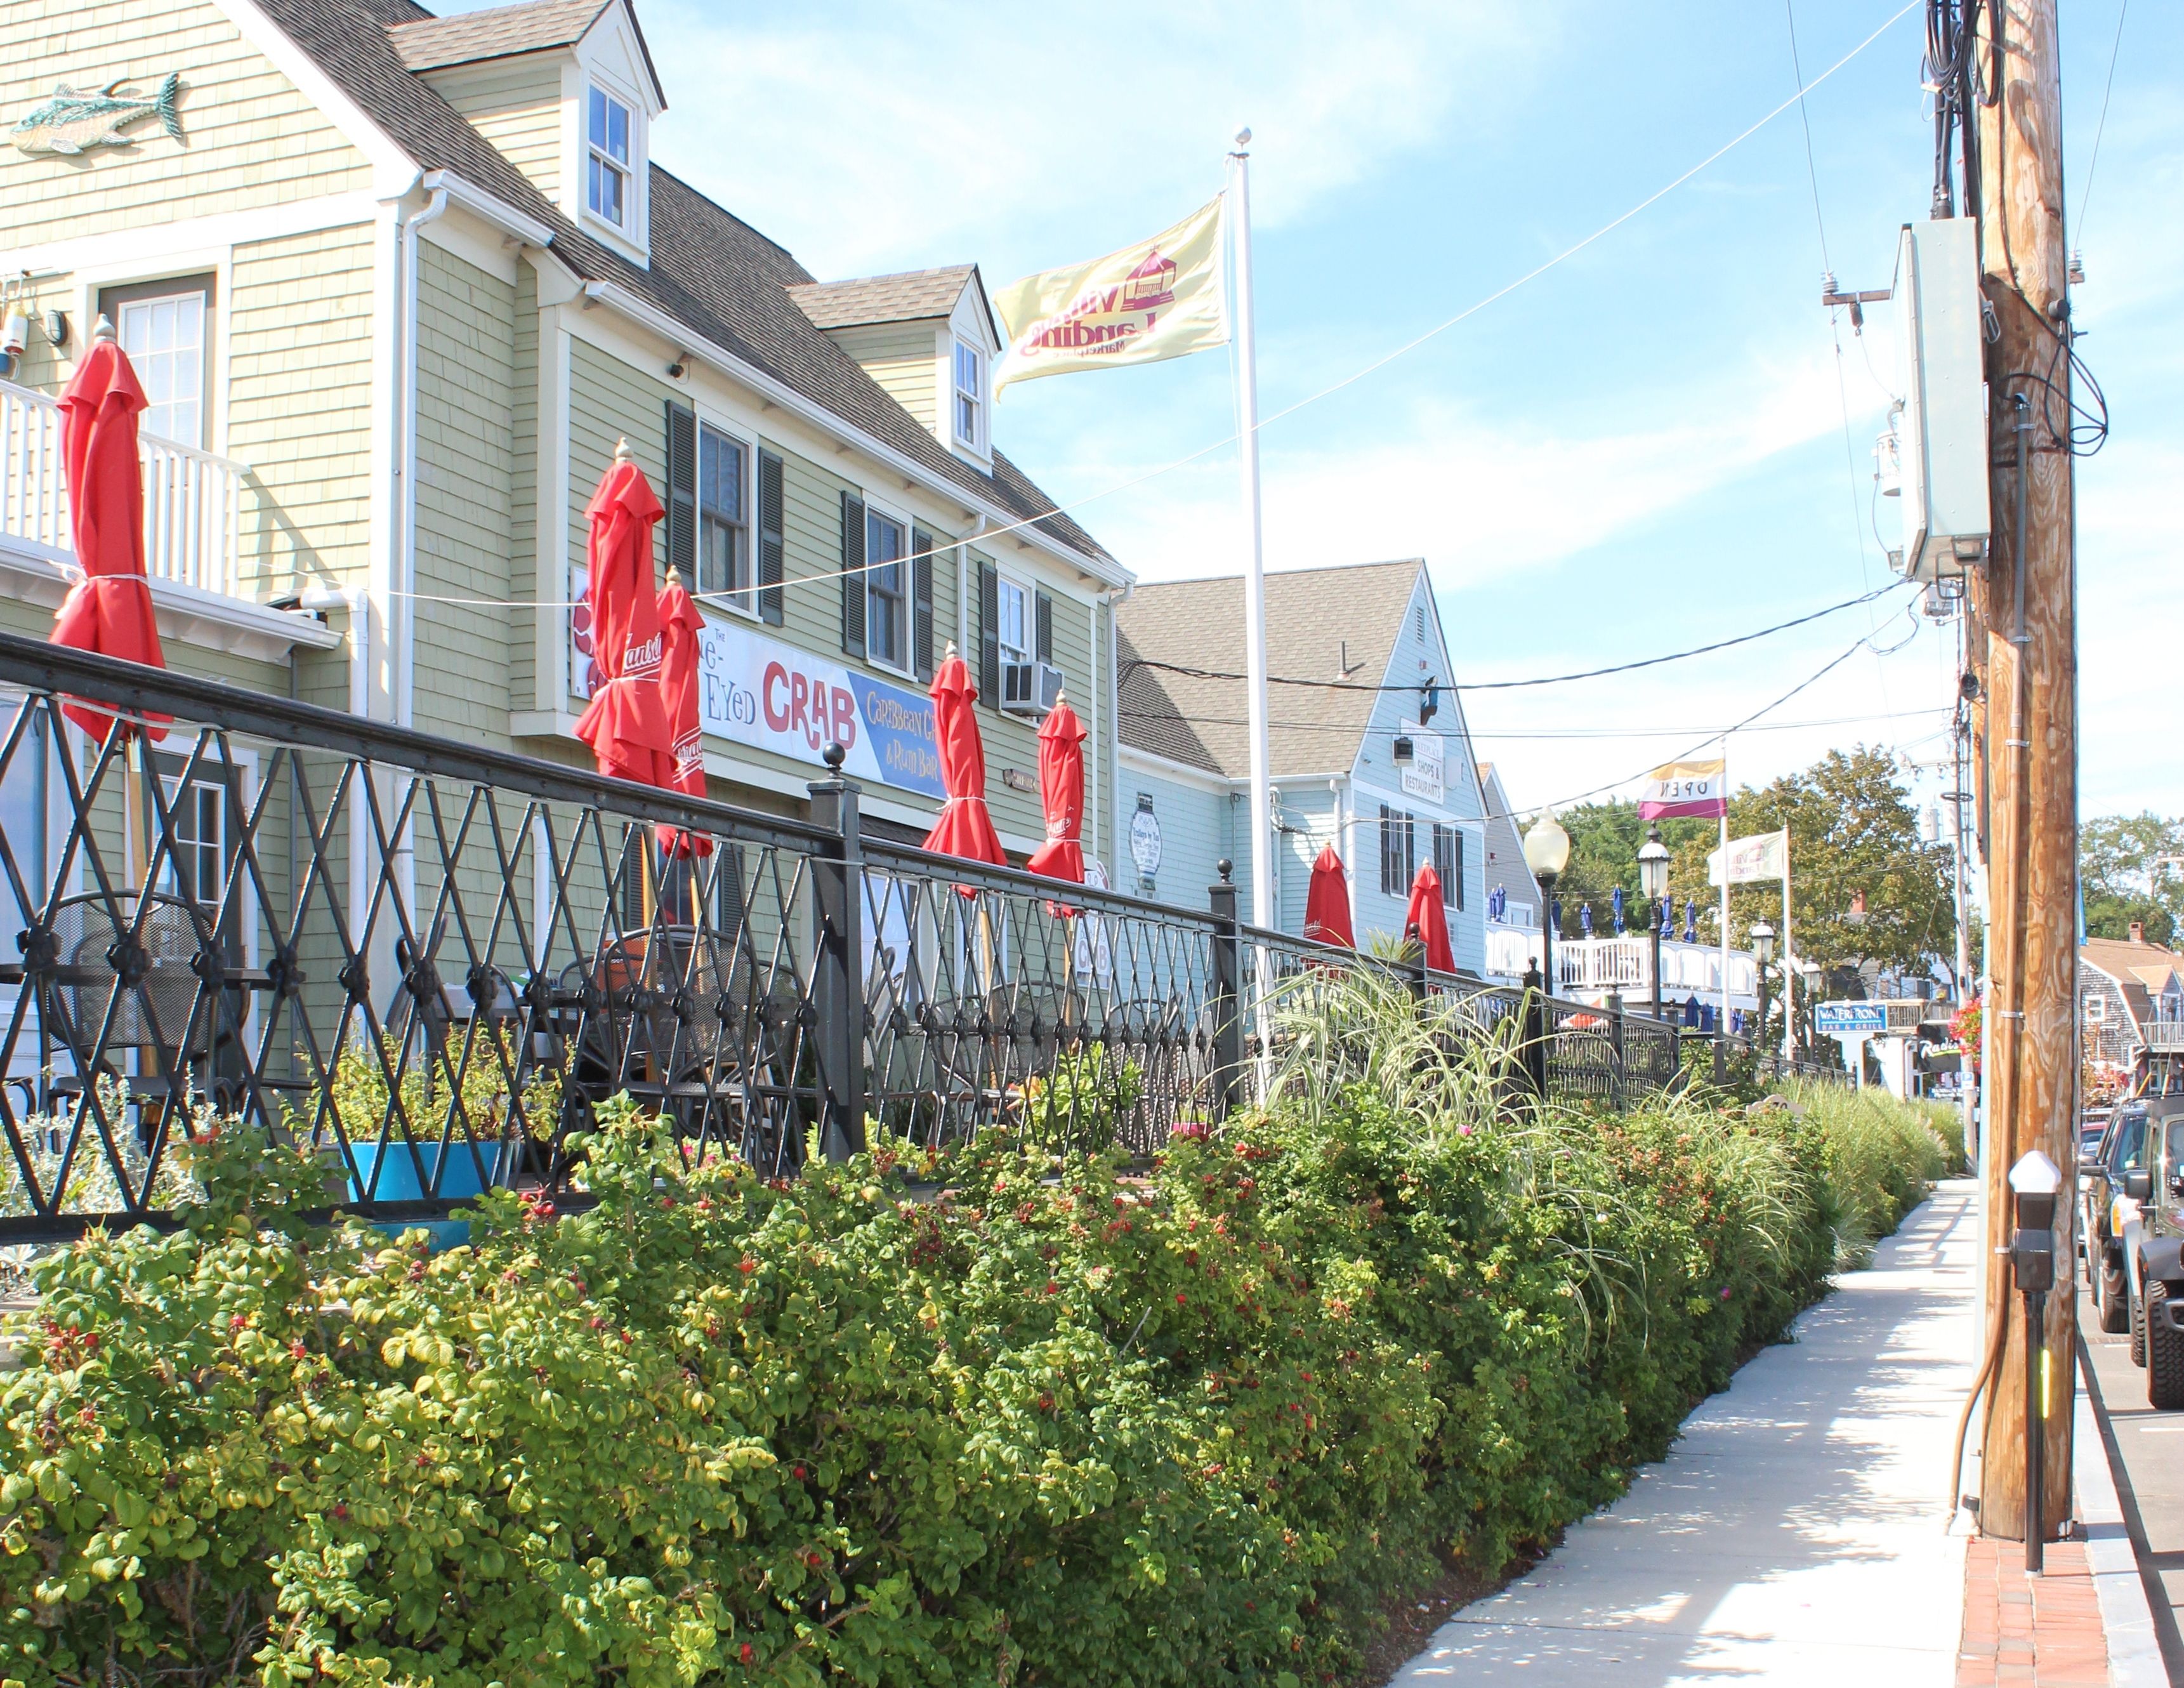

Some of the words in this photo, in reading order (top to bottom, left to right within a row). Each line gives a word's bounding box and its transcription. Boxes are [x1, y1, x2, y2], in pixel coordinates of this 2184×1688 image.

[763, 661, 857, 751] CRAB
[1417, 759, 1434, 778] SHOPS
[1405, 774, 1441, 799] RESTAURANTS
[1819, 1006, 1884, 1021] WATERFRONT
